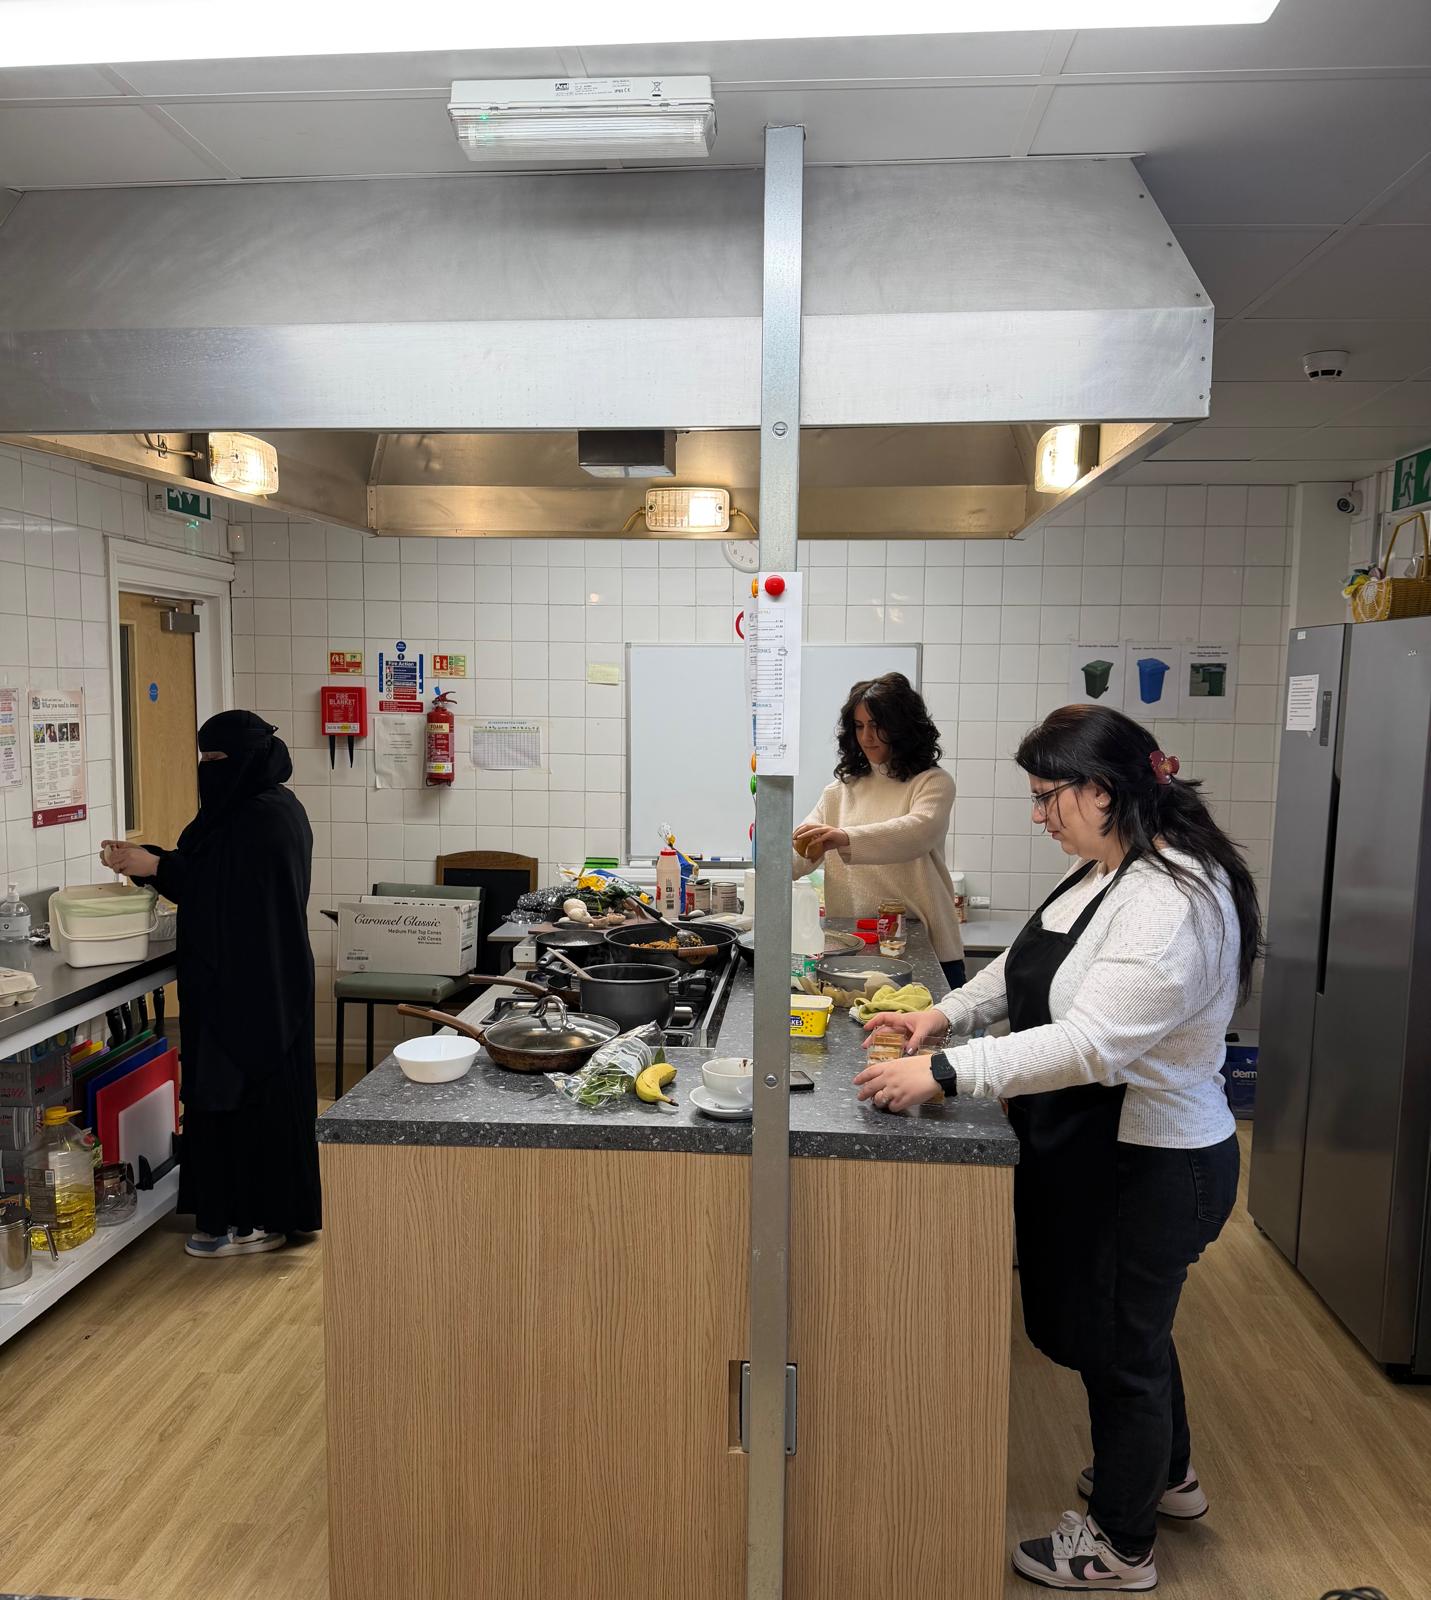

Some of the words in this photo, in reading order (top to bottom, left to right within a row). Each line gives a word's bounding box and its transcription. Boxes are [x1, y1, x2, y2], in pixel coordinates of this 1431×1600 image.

[335, 692, 349, 700] FIRE
[354, 913, 402, 927] Carousel
[403, 915, 441, 928] Classic
